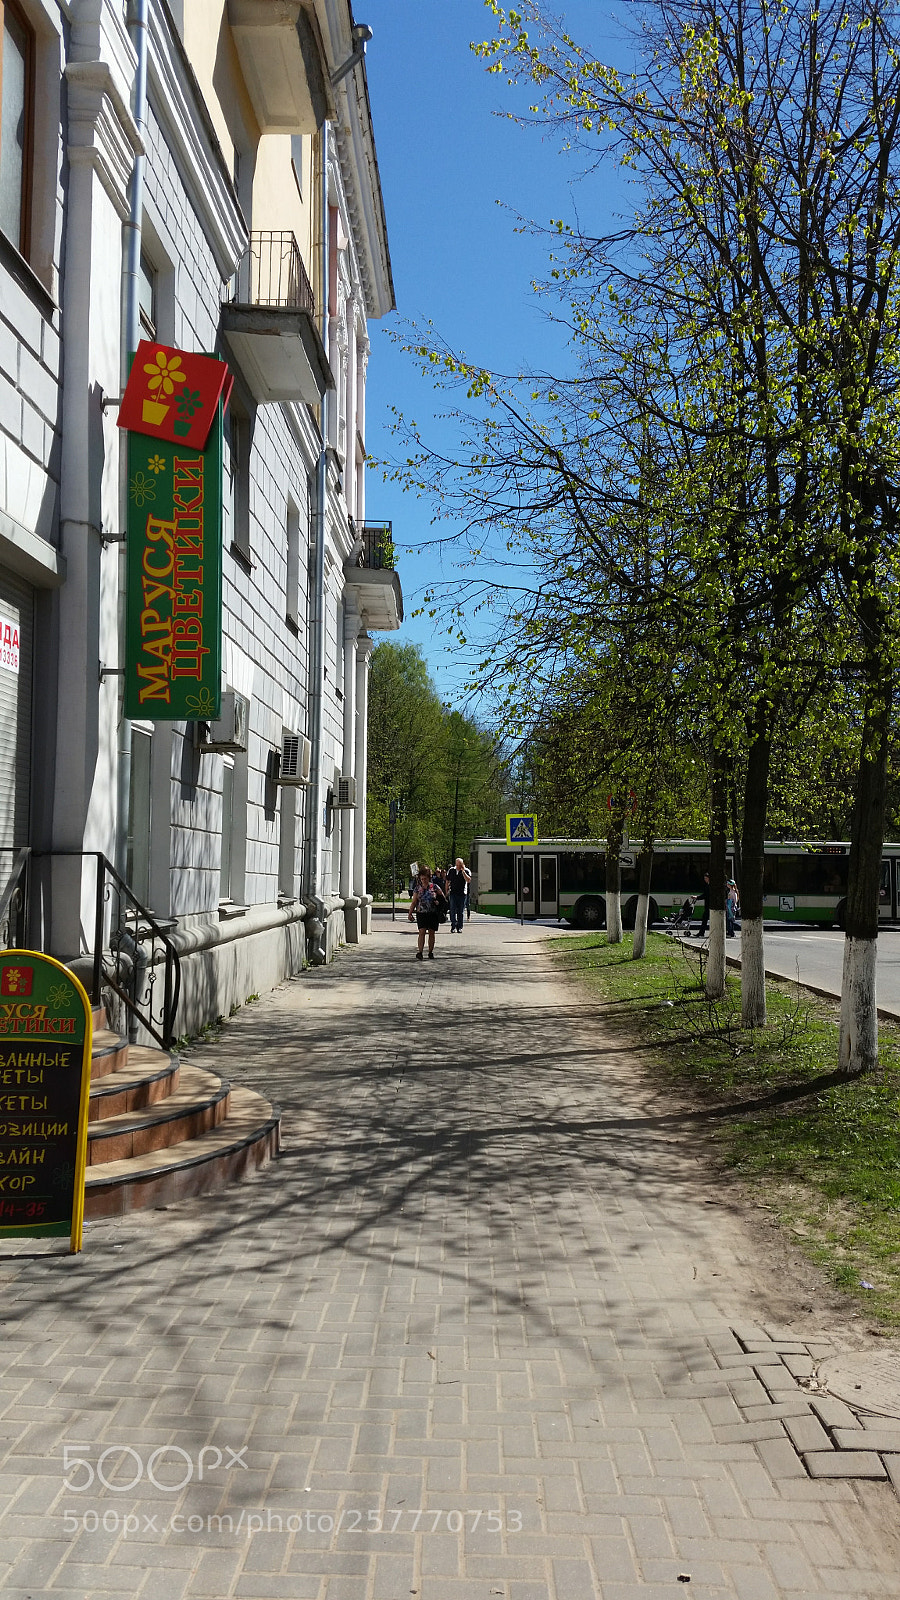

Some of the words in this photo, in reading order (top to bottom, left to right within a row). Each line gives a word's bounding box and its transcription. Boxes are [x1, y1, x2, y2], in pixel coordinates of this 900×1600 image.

[136, 513, 178, 704] МАРУСЯ
[171, 455, 210, 681] ЦВЕТИКИ
[0, 621, 20, 649] ДА
[0, 1069, 43, 1084] ЕТЫ
